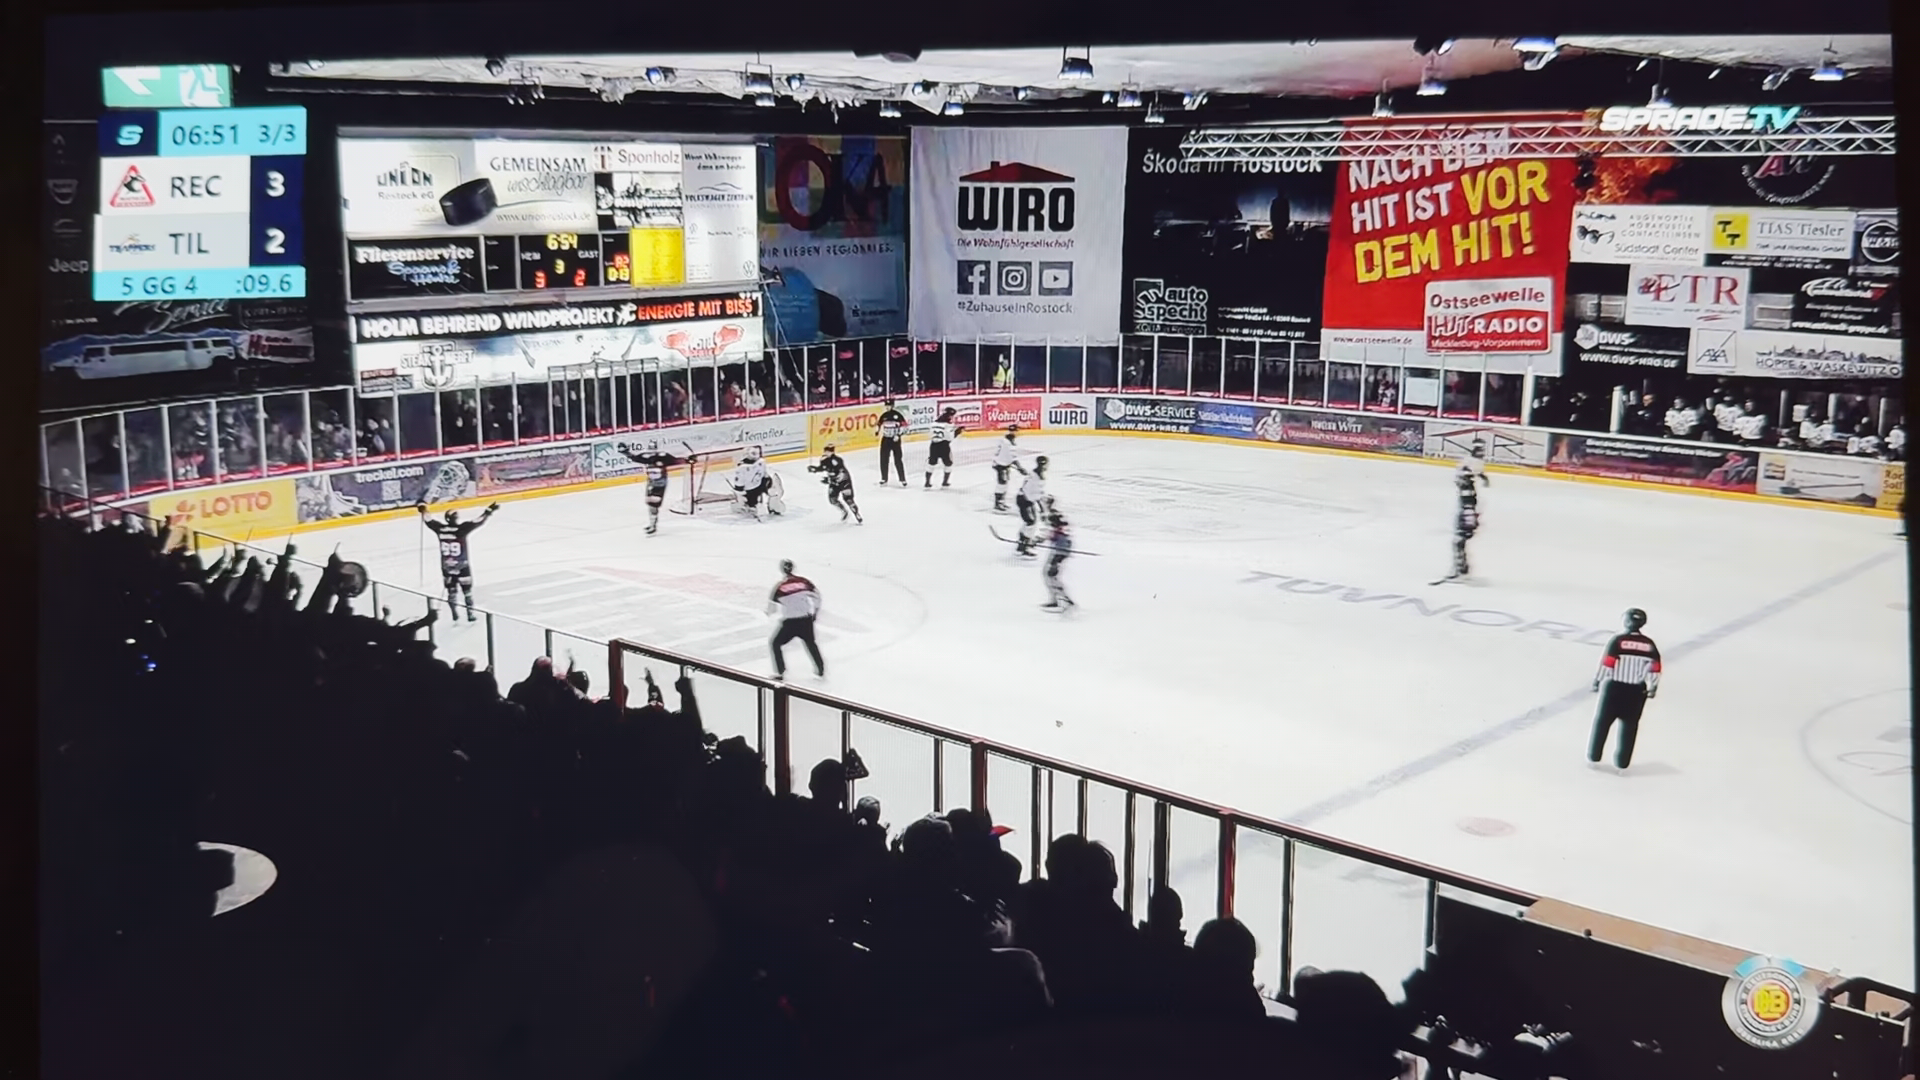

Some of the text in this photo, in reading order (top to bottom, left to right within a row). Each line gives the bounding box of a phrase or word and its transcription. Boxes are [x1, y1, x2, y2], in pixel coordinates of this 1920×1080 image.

[490, 155, 588, 173] GEMEINSAM
[618, 150, 680, 166] Sponholz
[1350, 160, 1550, 234] HIT IST VOR
[957, 187, 1076, 232] WIRO
[1797, 221, 1845, 236] Tiesler
[957, 237, 1075, 250] Die Wohnfühlgesellschaft
[1354, 211, 1536, 284] DEM HIT!
[1662, 244, 1700, 256] Center
[355, 244, 475, 263] Fliesenservice
[49, 258, 89, 274] Jeep
[574, 268, 586, 287] 2
[1164, 286, 1209, 303] auto
[1651, 273, 1740, 306] ETR
[957, 300, 1074, 314] #ZuhauseInRostock
[1430, 287, 1546, 310] Ostseewelle
[361, 316, 419, 339] HOLM
[420, 313, 501, 335] BEHREND
[502, 306, 615, 331] WINDPROJEKT
[638, 301, 695, 321] ENERGIE
[698, 301, 722, 317] MIT
[1145, 302, 1208, 322] specht
[1430, 339, 1543, 349] Mecklenburg-Vorpommern
[1699, 348, 1728, 364] AXA
[1756, 357, 1796, 369] HOPPE
[1809, 361, 1887, 374] WASKEWITZ
[912, 405, 935, 414] auto
[987, 407, 1039, 422] Wohnfühl
[1049, 410, 1089, 425] WIRO
[837, 413, 877, 432] LOTTO
[355, 465, 424, 483] treckel.com
[201, 490, 272, 519] LOTTO
